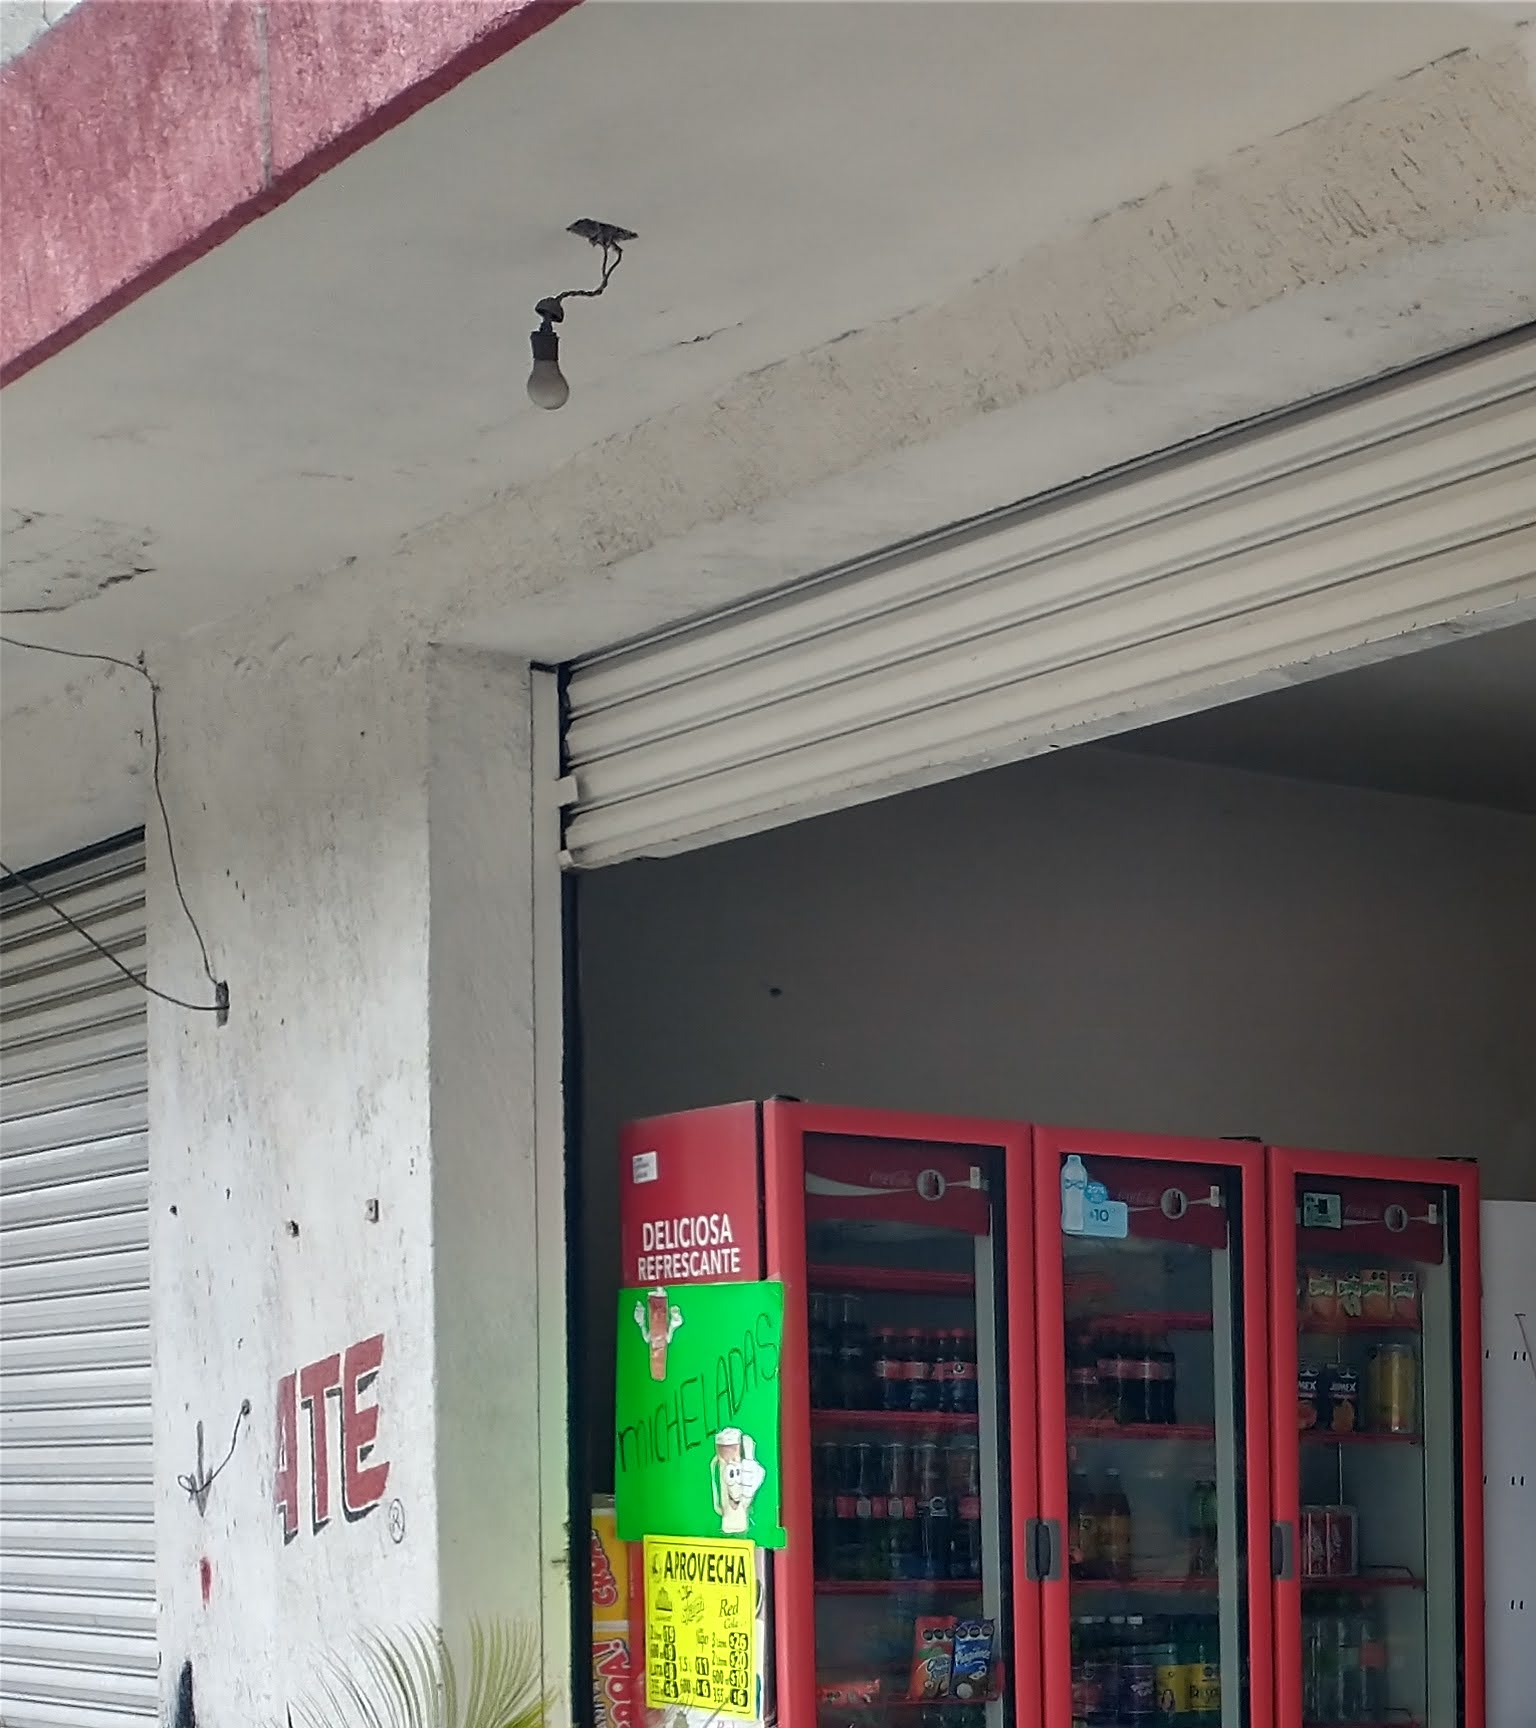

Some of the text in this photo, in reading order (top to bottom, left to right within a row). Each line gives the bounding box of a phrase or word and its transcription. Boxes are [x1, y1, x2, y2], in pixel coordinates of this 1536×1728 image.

[642, 1213, 733, 1252] DELICIOSA
[638, 1247, 741, 1281] REFRESCANTE
[663, 1550, 748, 1585] APROVECHA
[718, 1595, 739, 1618] Red
